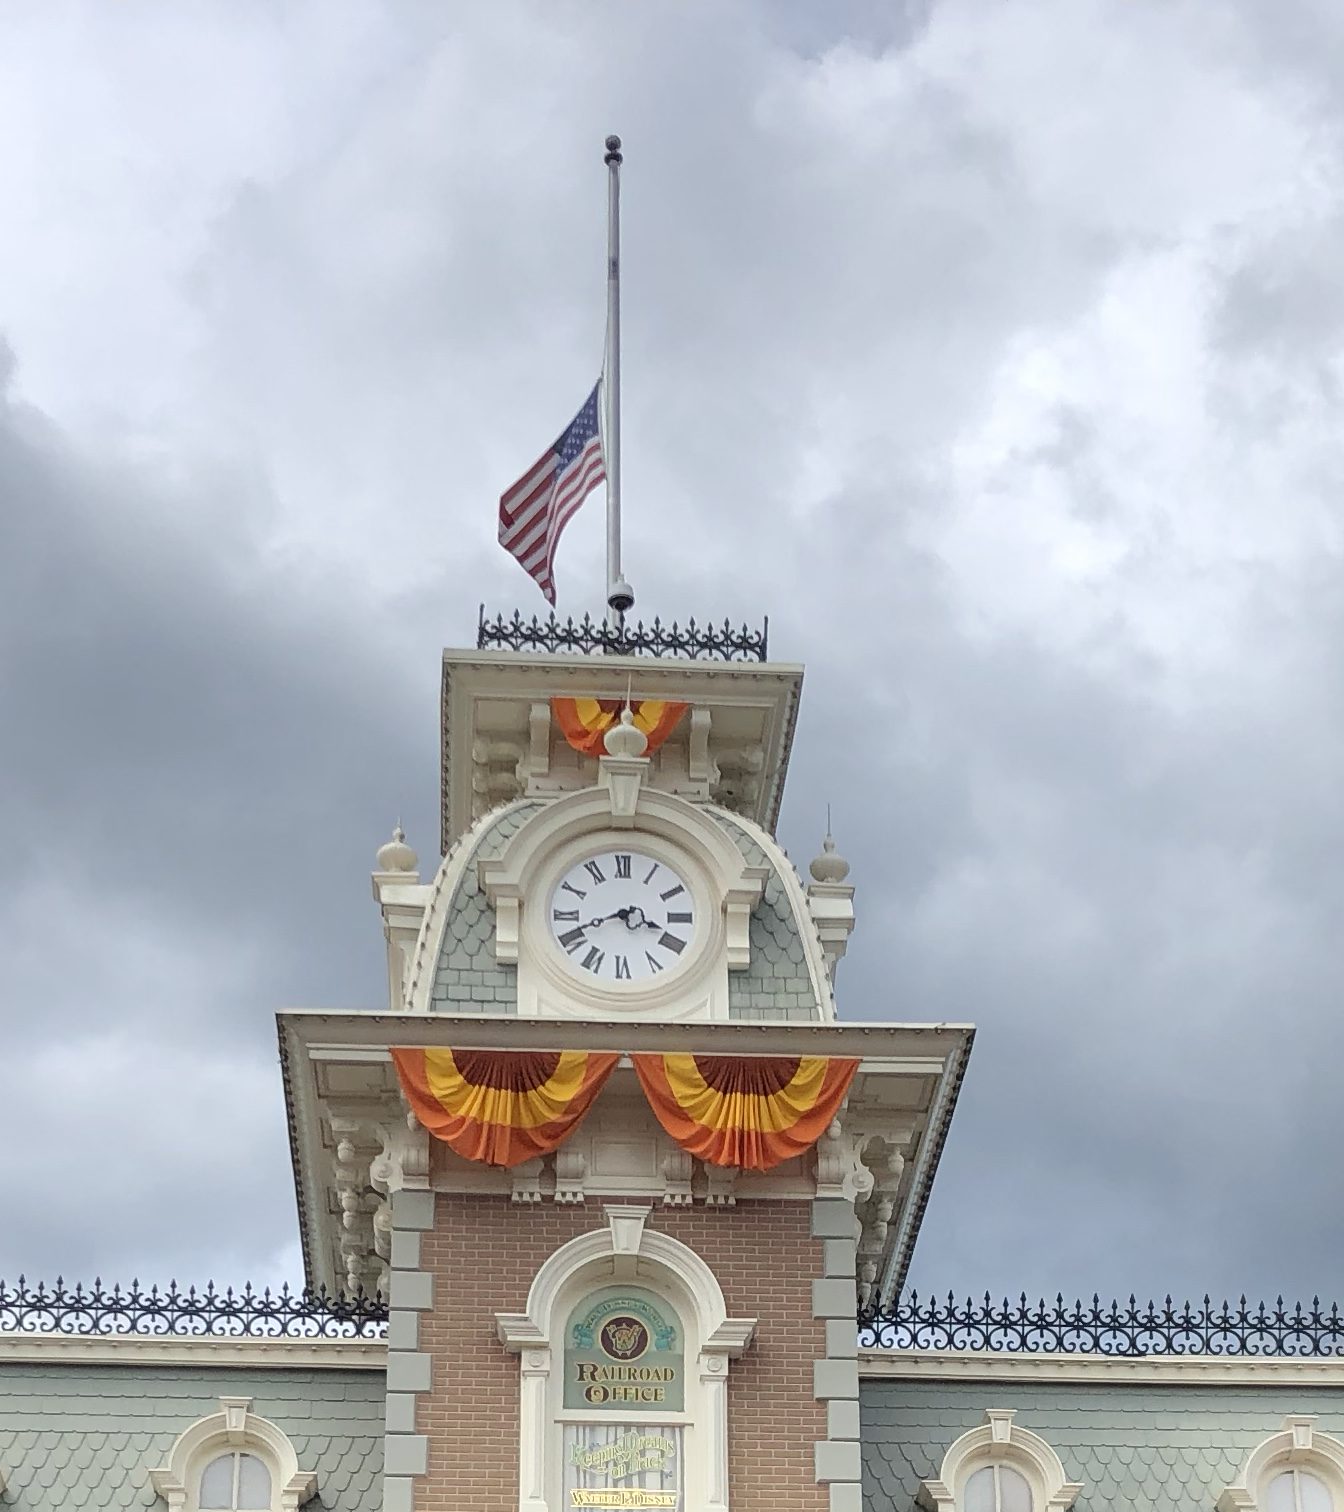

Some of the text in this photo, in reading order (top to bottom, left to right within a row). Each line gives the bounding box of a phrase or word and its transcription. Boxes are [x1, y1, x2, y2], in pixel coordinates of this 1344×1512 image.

[614, 854, 632, 879] XII
[575, 1362, 675, 1383] RAILROAD
[584, 1384, 665, 1404] OFFICE
